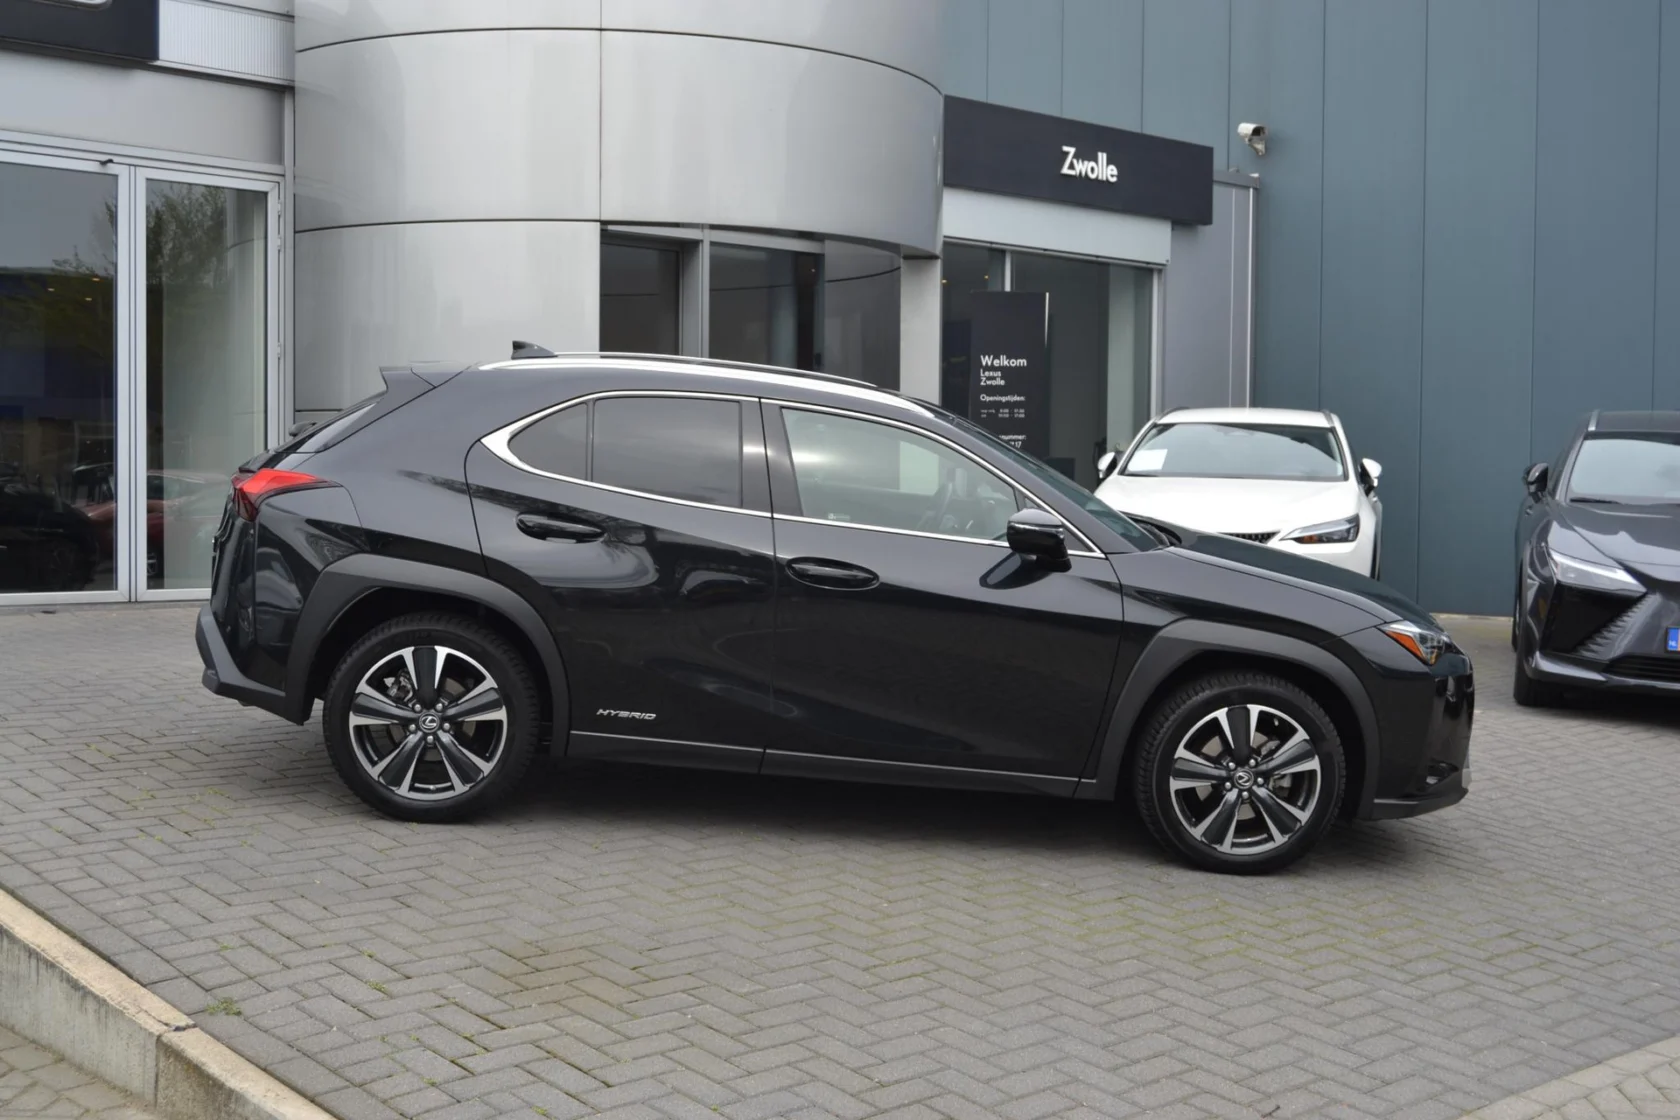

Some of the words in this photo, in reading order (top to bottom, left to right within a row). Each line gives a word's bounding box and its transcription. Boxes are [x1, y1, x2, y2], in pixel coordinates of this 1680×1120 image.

[1060, 145, 1119, 183] Zwolle
[980, 354, 1027, 367] Welkom
[980, 368, 1002, 377] Lexus
[980, 377, 1006, 386] Zwolle
[596, 708, 657, 720] HYBRID
